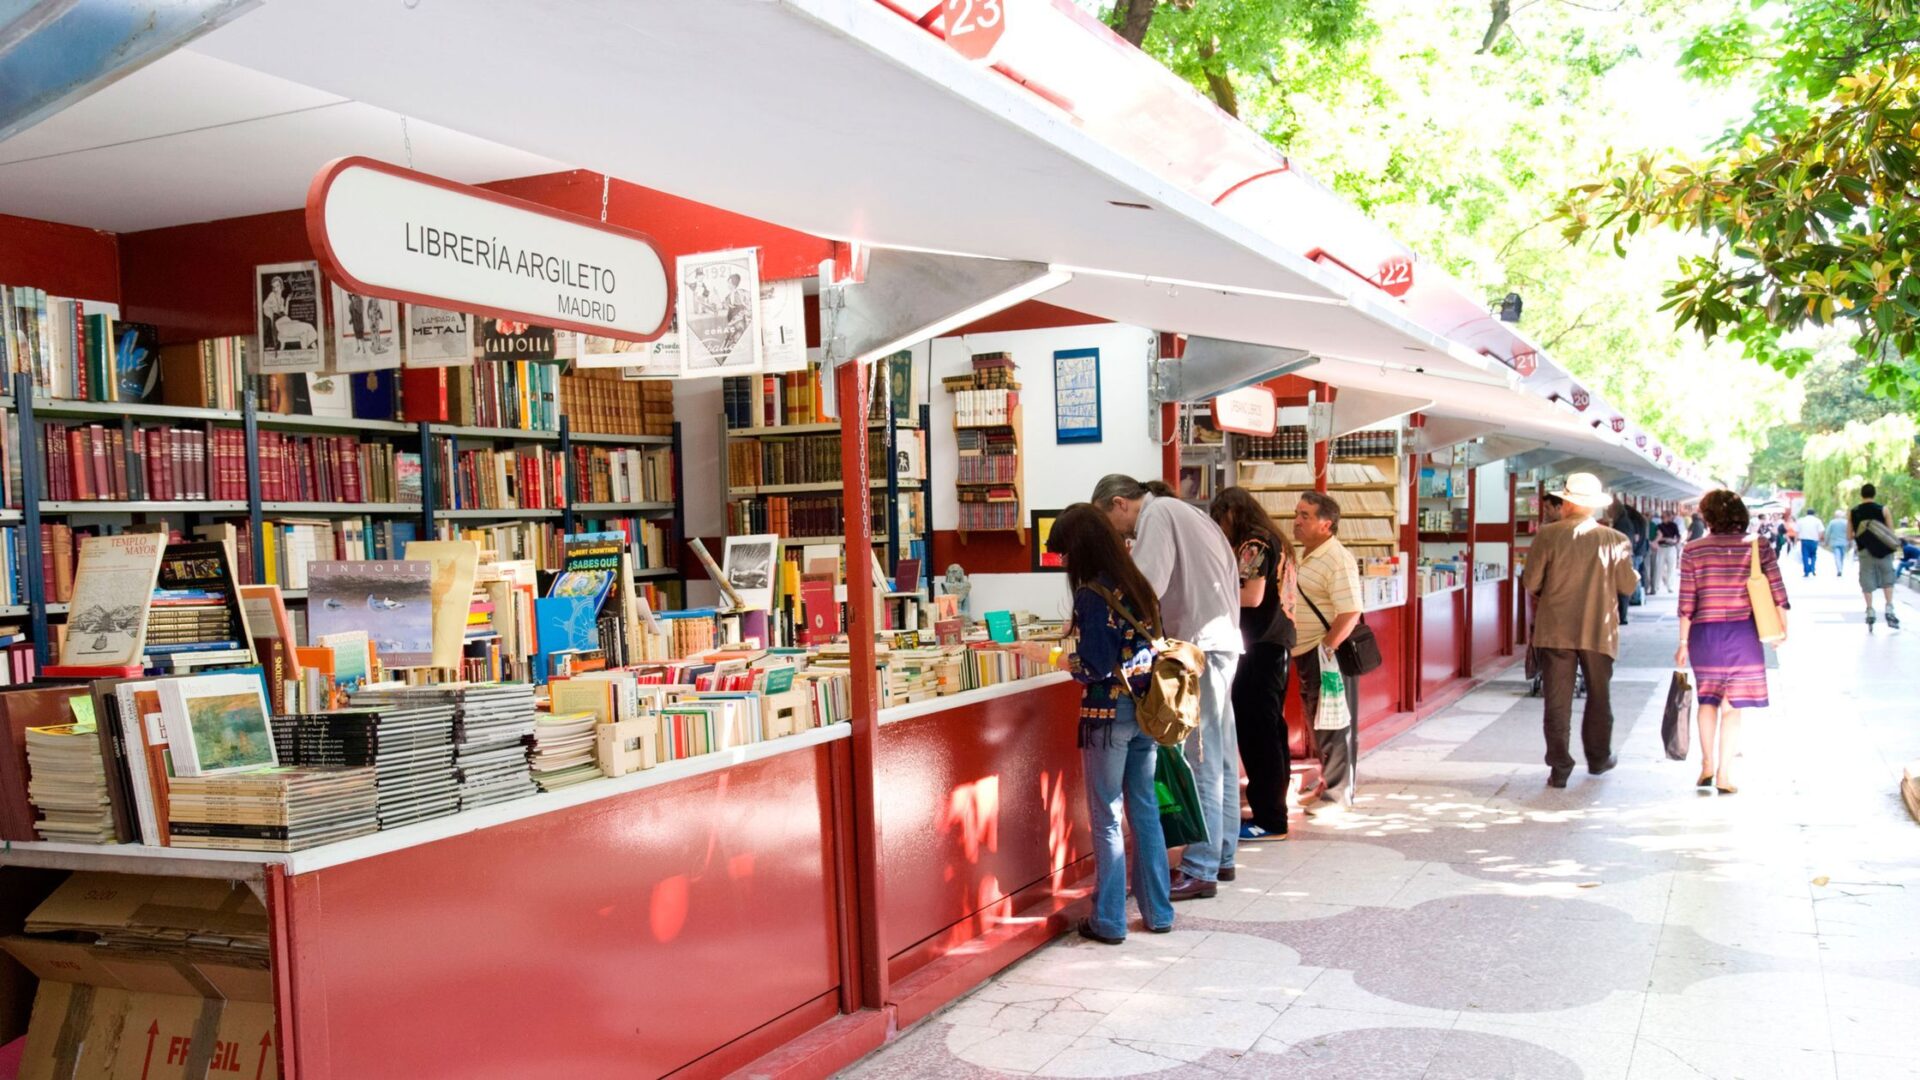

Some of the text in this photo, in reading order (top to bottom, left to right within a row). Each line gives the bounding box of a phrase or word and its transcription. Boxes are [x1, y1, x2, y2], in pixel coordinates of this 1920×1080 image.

[948, 0, 1001, 36] 23
[406, 222, 616, 294] LIBRERÍA ARGILETO
[1381, 262, 1410, 287] 22
[558, 294, 616, 323] MADRID
[412, 325, 466, 336] METAL
[1517, 355, 1536, 369] 21
[1574, 393, 1589, 407] 20
[1612, 420, 1624, 430] 19
[111, 537, 147, 548] TEMPLO
[126, 545, 157, 556] MAYOR
[310, 564, 430, 573] PINTORES
[567, 555, 618, 572] ¿SABES QUÉ
[167, 1036, 240, 1072] FGIL
